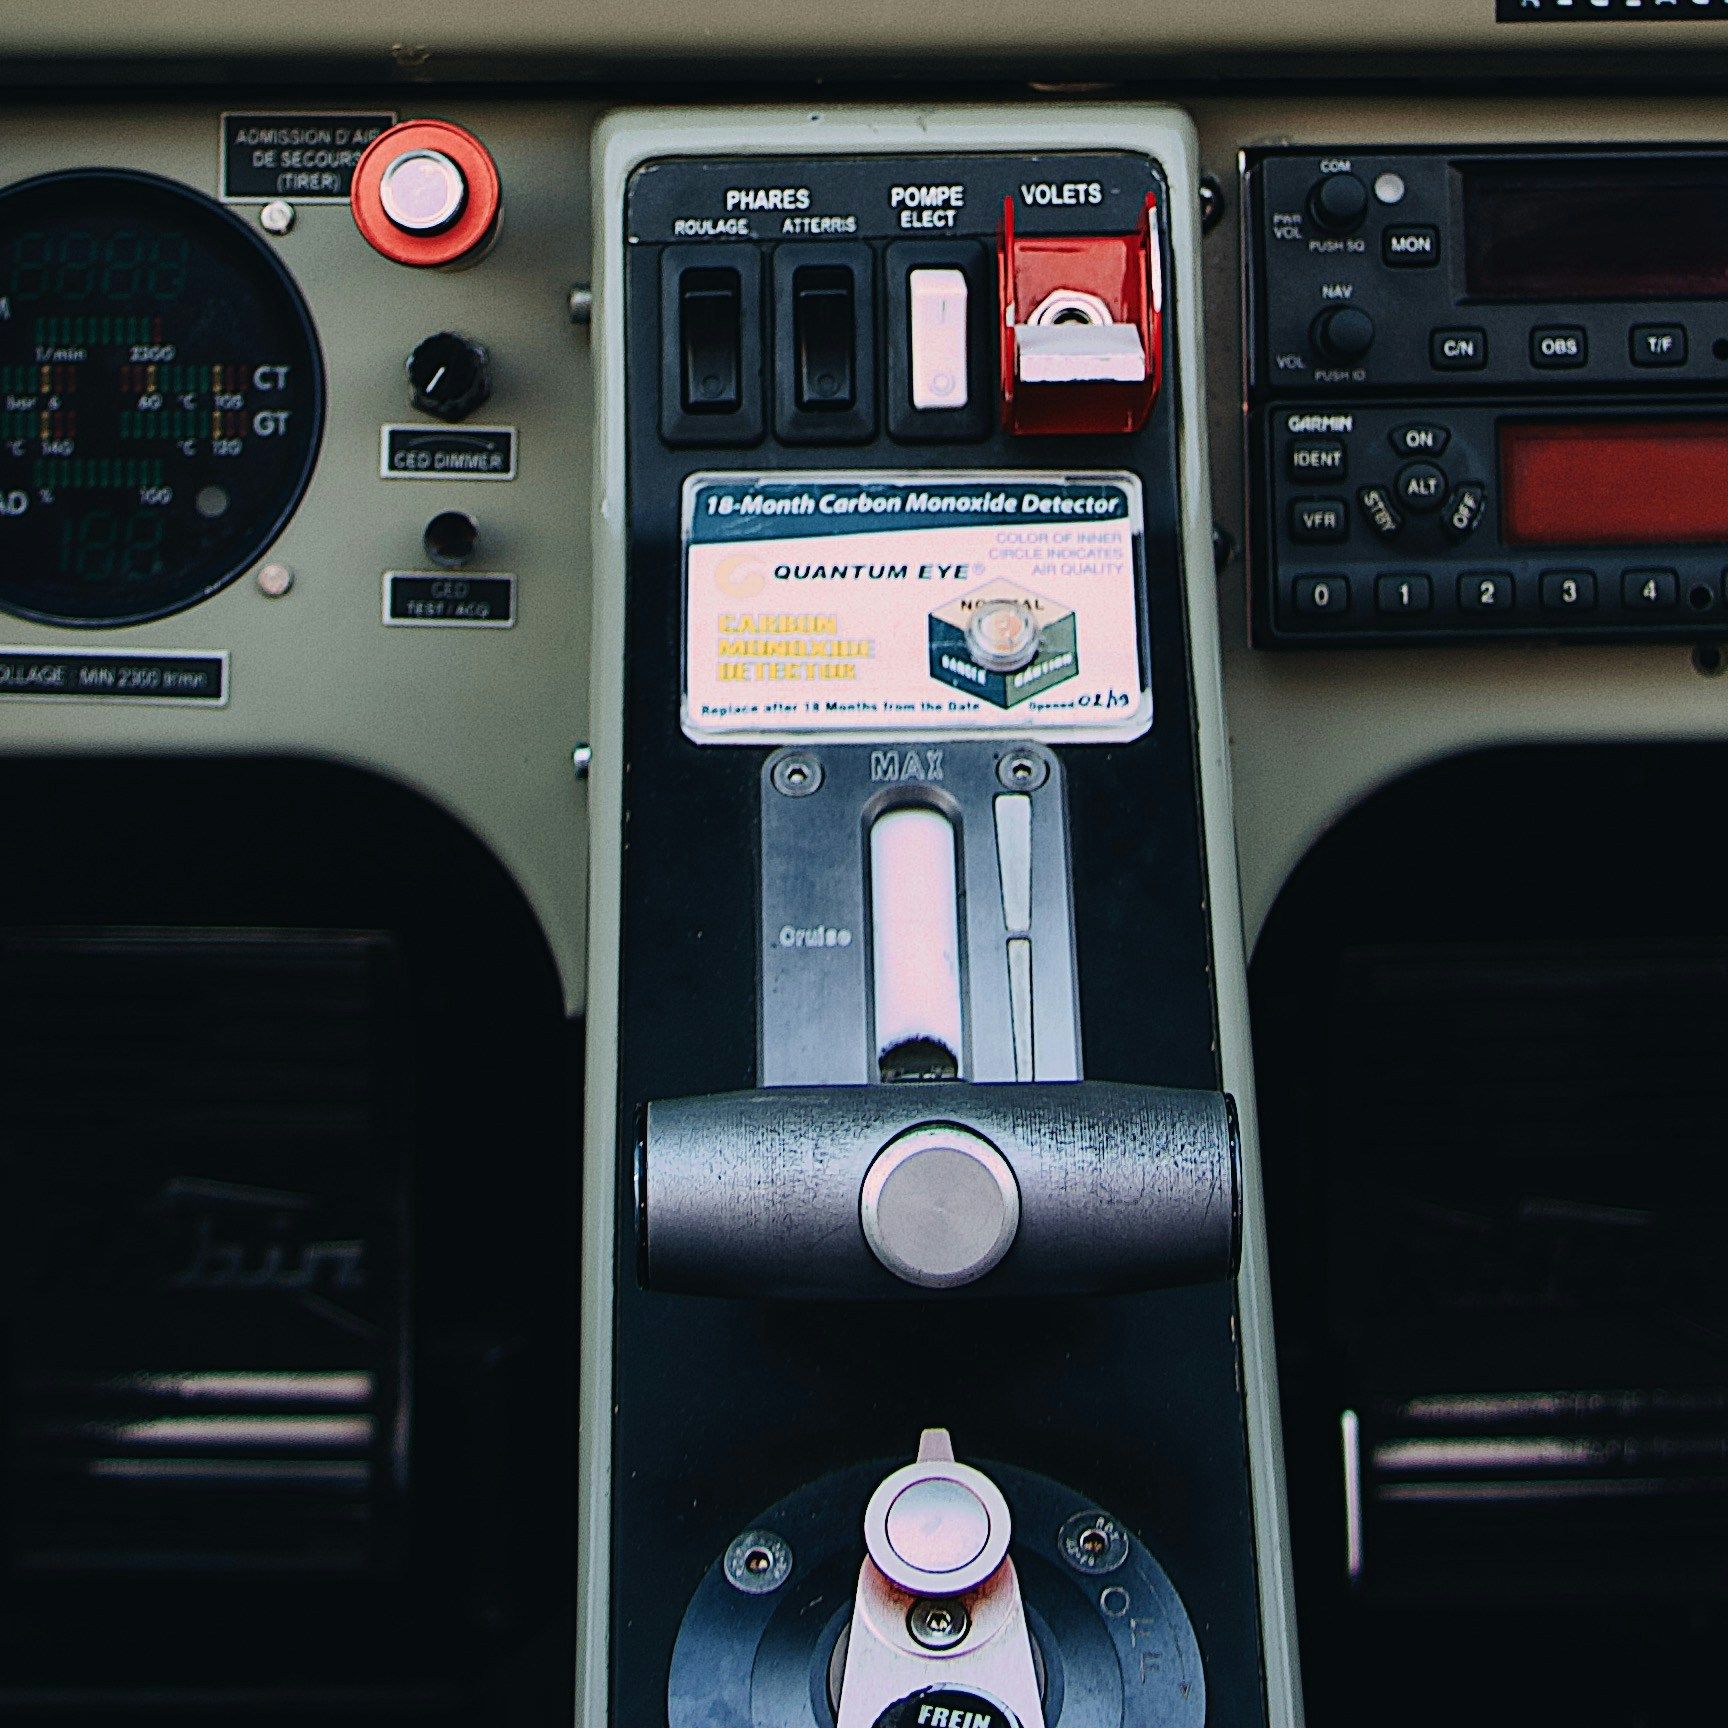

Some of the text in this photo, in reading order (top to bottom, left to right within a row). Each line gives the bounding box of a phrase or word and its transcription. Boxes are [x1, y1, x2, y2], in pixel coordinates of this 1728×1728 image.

[727, 190, 810, 210] PHARES
[891, 187, 964, 207] POMPE
[1021, 185, 1101, 204] VOLETS
[675, 220, 748, 235] ROULAGE
[783, 218, 856, 234] ATTERRIS
[900, 210, 956, 228] ELECT
[1392, 237, 1430, 252] MON
[1542, 340, 1577, 355] OBS
[434, 453, 502, 469] DIMMER
[1294, 451, 1342, 466] IDENT
[707, 494, 1119, 516] 18-Month Carbon Monoxide Detector
[774, 565, 968, 579] QUANTUM EYE
[780, 926, 851, 948] Cruise
[918, 1704, 990, 1728] FREIN
